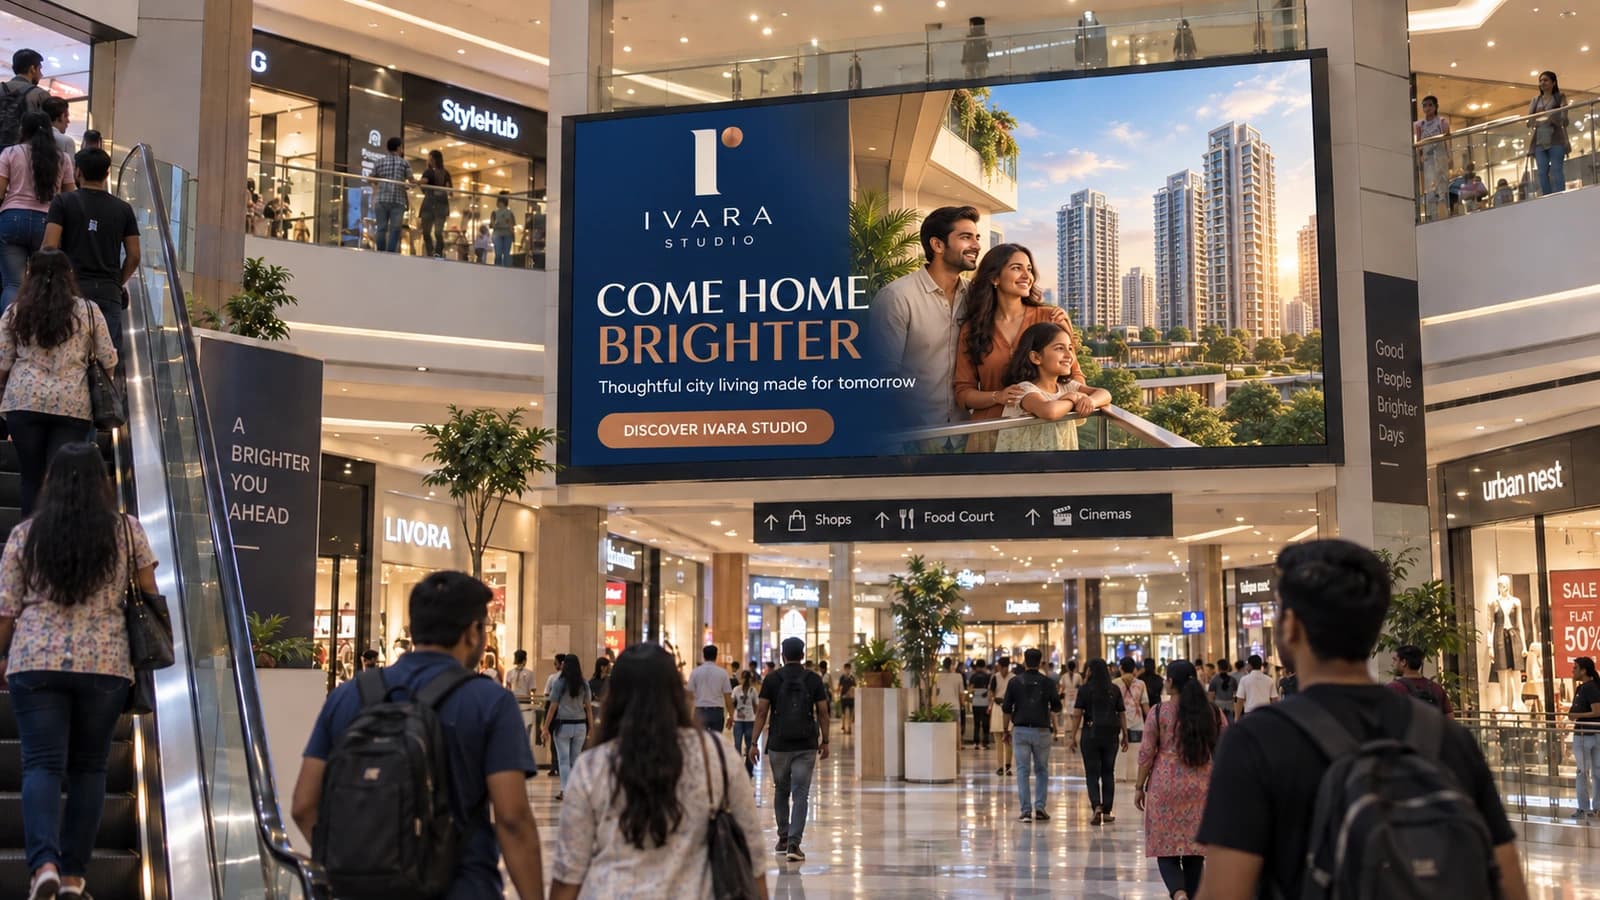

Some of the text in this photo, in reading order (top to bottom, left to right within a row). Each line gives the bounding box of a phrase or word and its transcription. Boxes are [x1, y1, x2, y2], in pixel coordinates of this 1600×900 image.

[441, 99, 519, 140] StyleHub
[644, 205, 773, 230] IVARA
[664, 235, 755, 249] STUDIO
[597, 275, 870, 317] COME HOME
[599, 319, 862, 366] BRIGHTER
[1375, 339, 1404, 360] Good
[598, 375, 917, 397] Thoughtful city living made for tomorrow
[1376, 367, 1412, 391] People
[1377, 395, 1418, 419] Brighter
[232, 416, 246, 435] A
[624, 420, 808, 437] DISCOVER IVARA STUDIO
[1378, 423, 1405, 447] Days
[231, 444, 310, 472] BRIGHTER
[230, 473, 268, 494] YOU
[1483, 460, 1563, 502] urban nest
[229, 502, 290, 525] AHEAD
[815, 513, 852, 527] Shops
[924, 510, 995, 523] Food Court
[1079, 508, 1132, 521] Cinemas
[385, 516, 451, 550] LIVORA
[1563, 582, 1598, 599] SALE
[1569, 611, 1594, 622] FLAT
[1564, 626, 1600, 652] 50%
